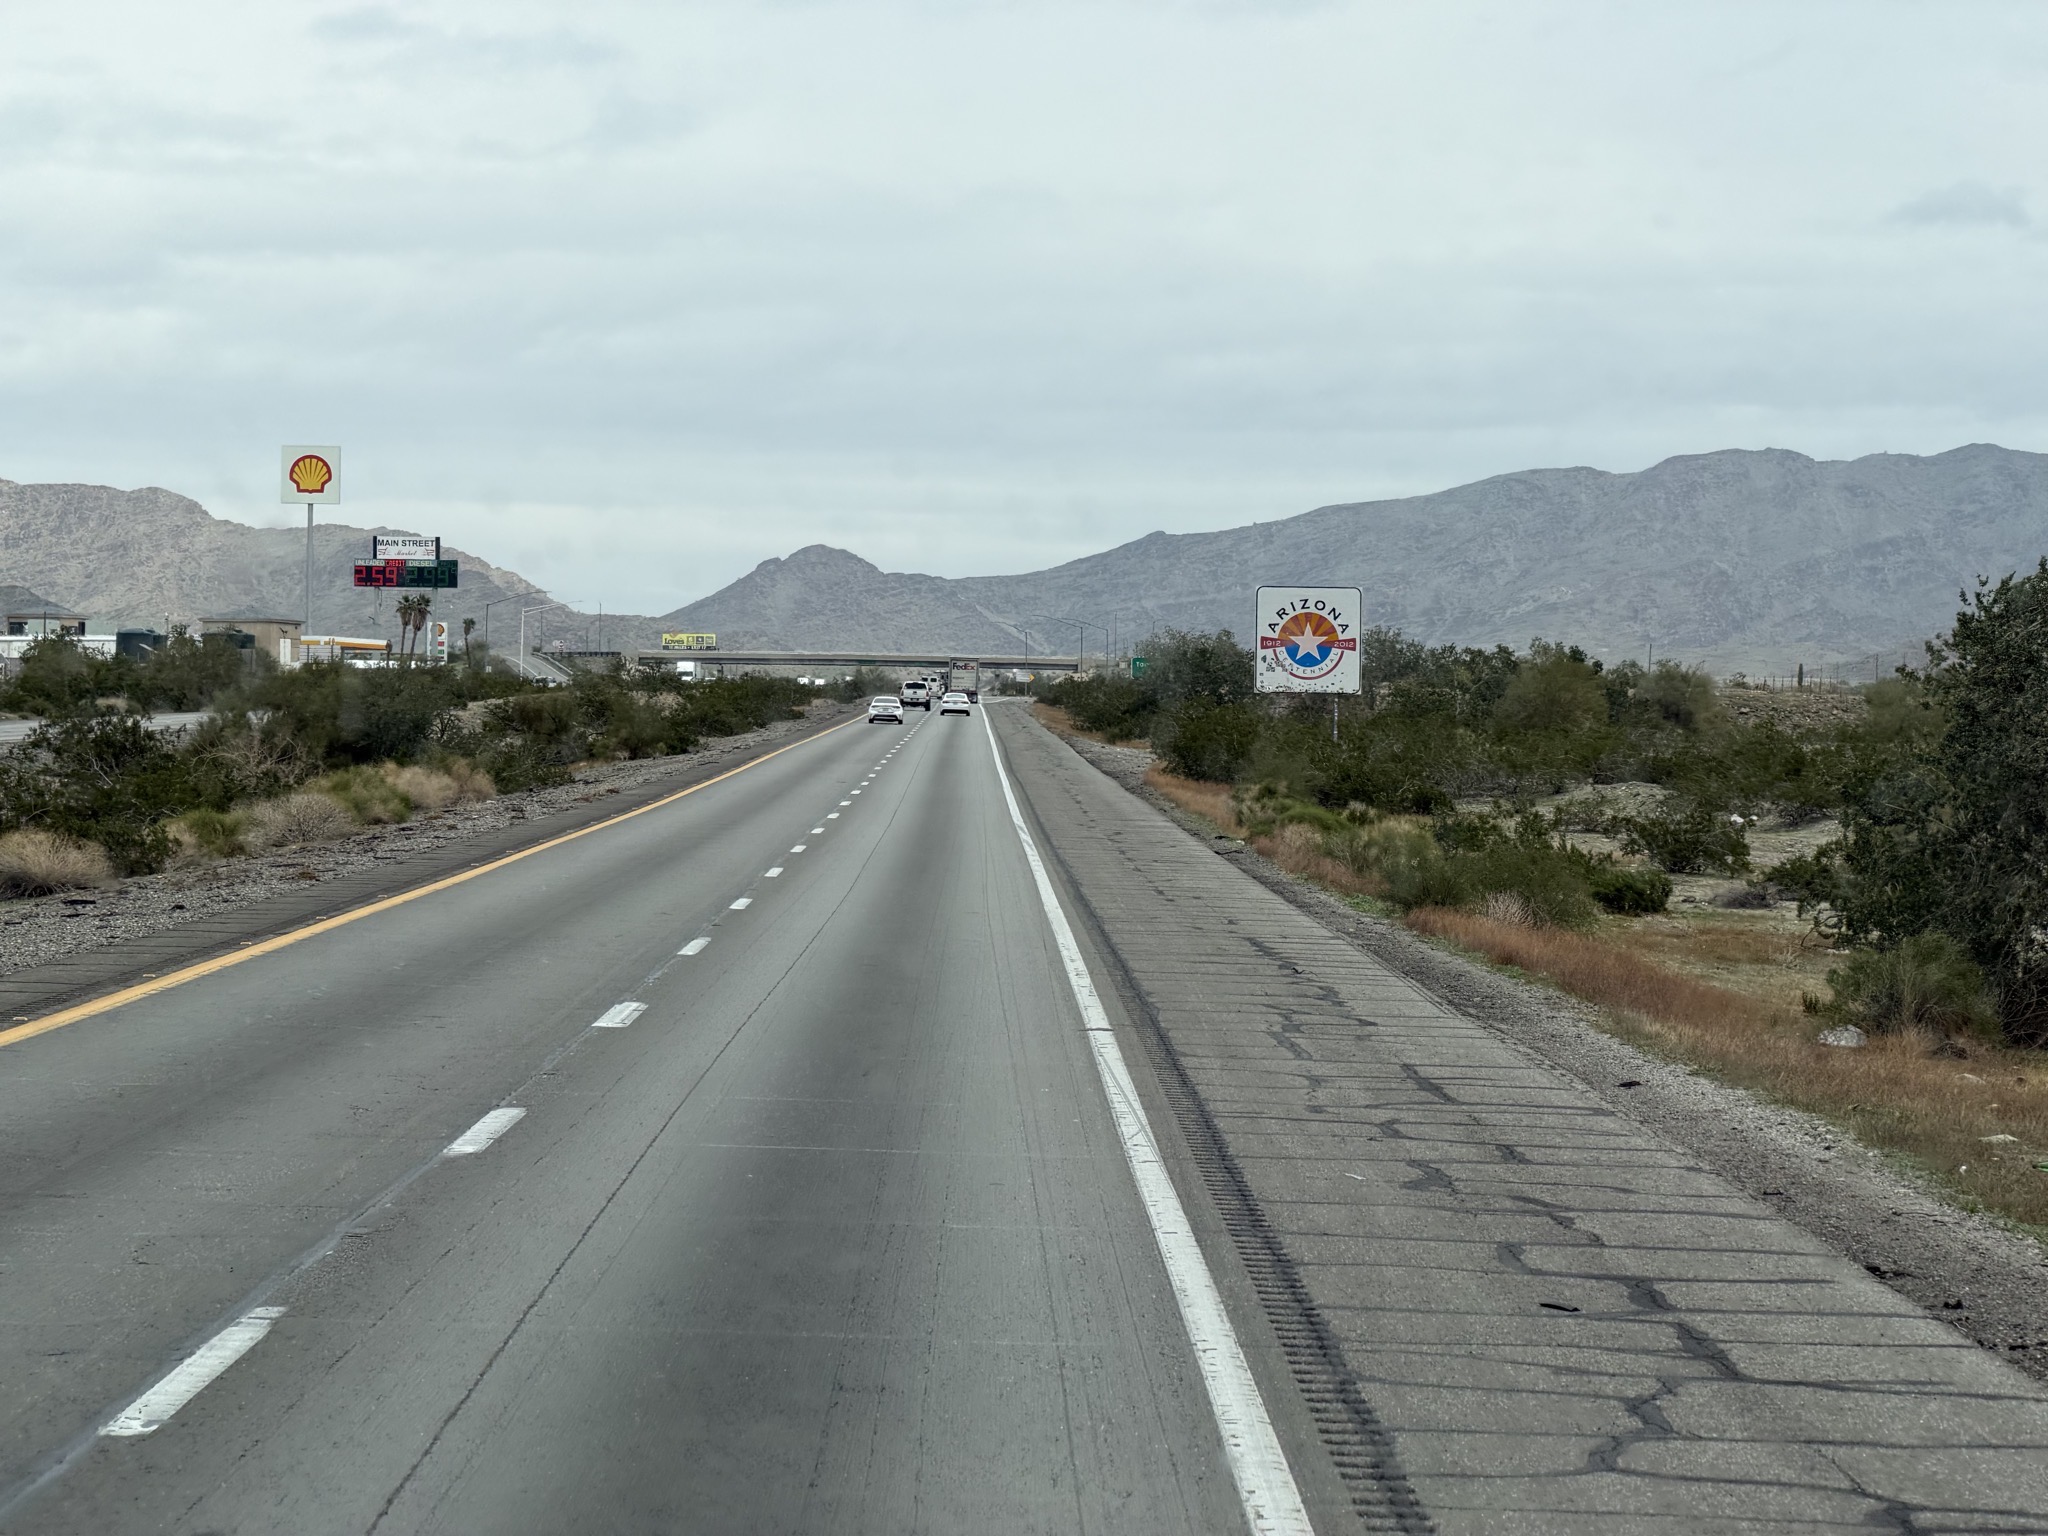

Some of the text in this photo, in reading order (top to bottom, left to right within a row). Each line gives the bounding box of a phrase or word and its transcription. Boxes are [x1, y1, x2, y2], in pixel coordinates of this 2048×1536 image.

[401, 539, 435, 547] STREET
[1268, 598, 1349, 635] ARIZONA
[952, 662, 976, 670] FedEx
[1278, 650, 1339, 675] CENTENNIAL
